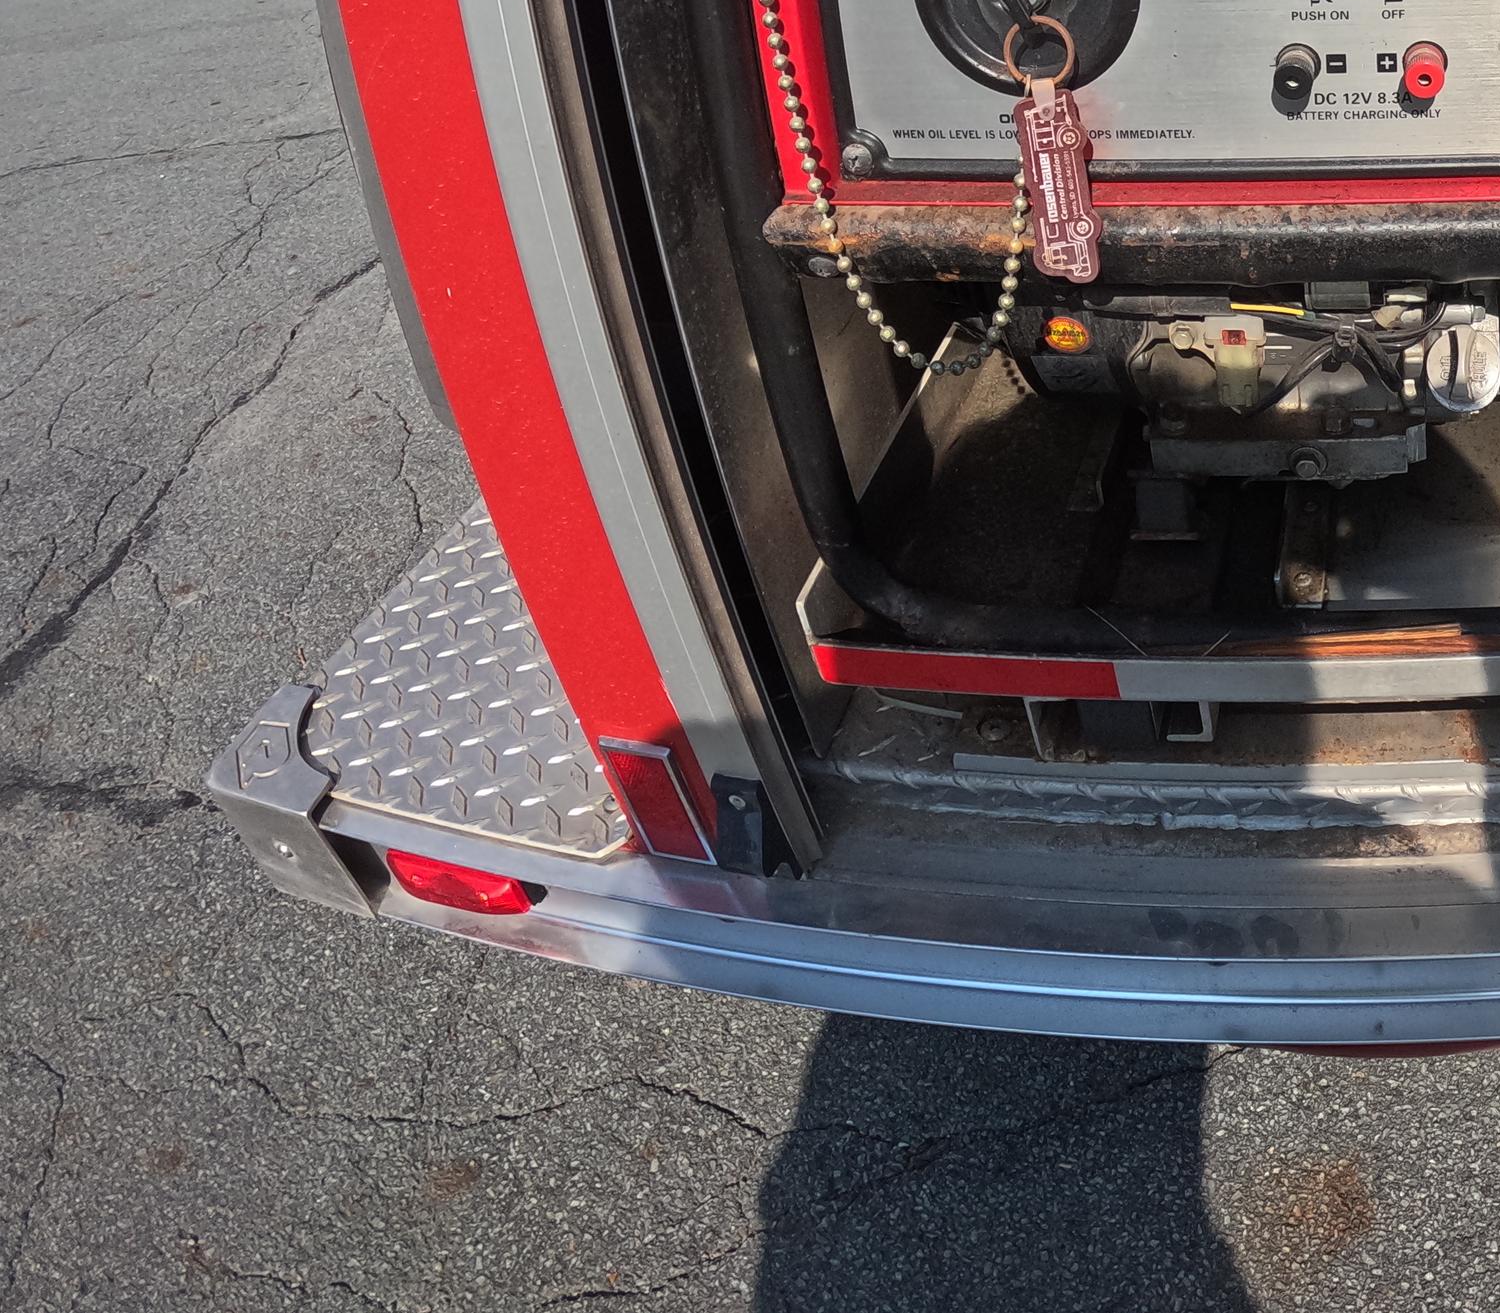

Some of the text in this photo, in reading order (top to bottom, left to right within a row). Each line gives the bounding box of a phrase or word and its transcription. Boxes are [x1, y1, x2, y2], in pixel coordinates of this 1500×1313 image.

[1291, 10, 1349, 21] PUSH ON
[1381, 9, 1405, 19] OFF
[1314, 92, 1413, 105] DC 12V 8.3A
[1286, 109, 1441, 121] BATTERY CHARGING ONLY
[892, 129, 925, 139] WHEN
[928, 129, 946, 139] OIL
[949, 129, 981, 139] LEVEL
[985, 129, 996, 139] IS
[1115, 129, 1195, 139] IMMEDIATELY.
[1038, 152, 1060, 224] rosenbauer
[1053, 153, 1068, 220] Central Division
